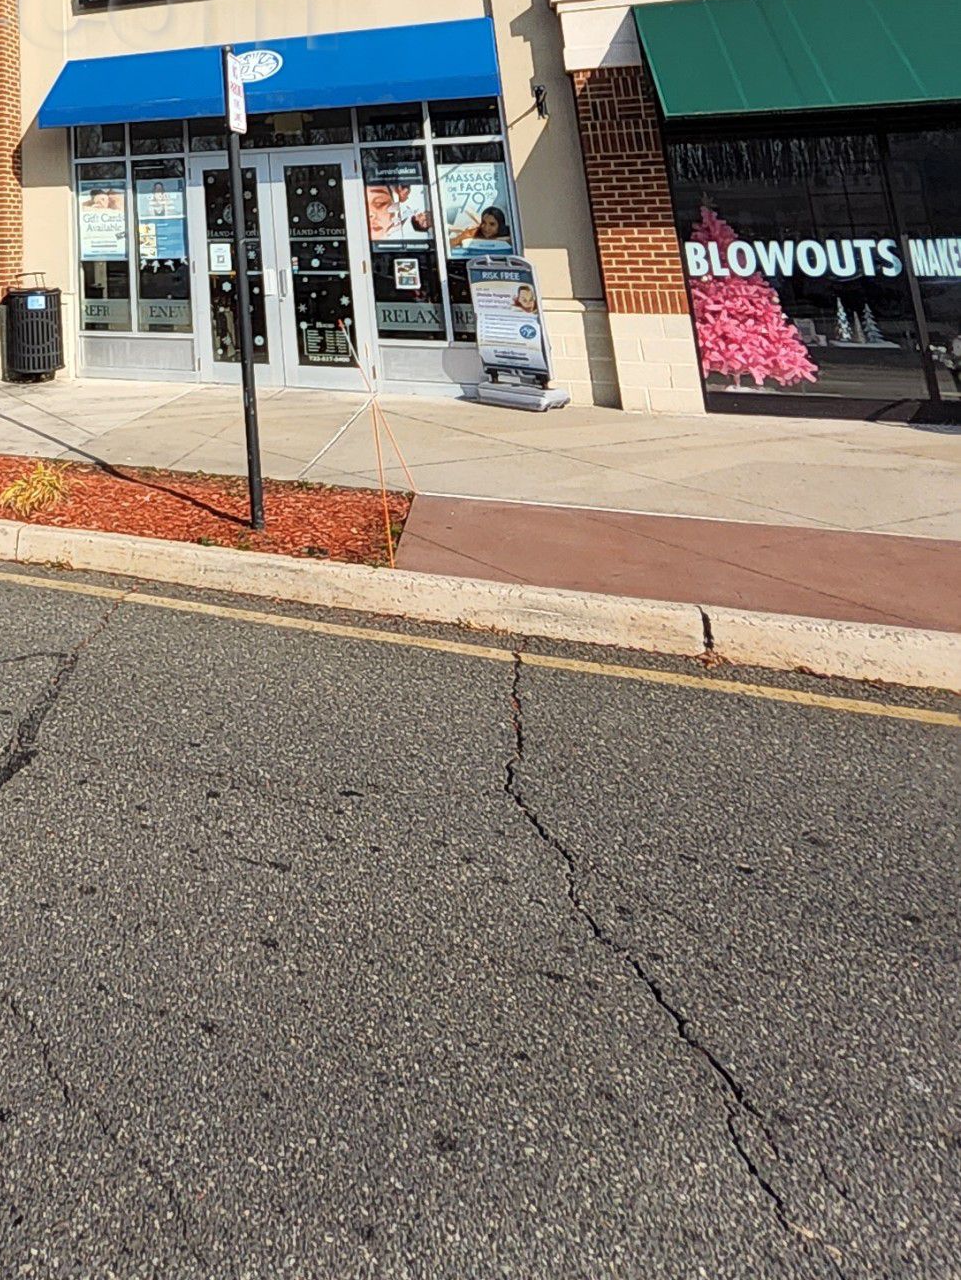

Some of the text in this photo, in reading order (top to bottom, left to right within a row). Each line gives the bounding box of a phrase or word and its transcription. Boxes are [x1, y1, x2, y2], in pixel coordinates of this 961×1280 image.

[445, 173, 499, 183] MASSAGE
[684, 238, 903, 278] BLOWOUTS
[382, 309, 441, 324] RELAX
